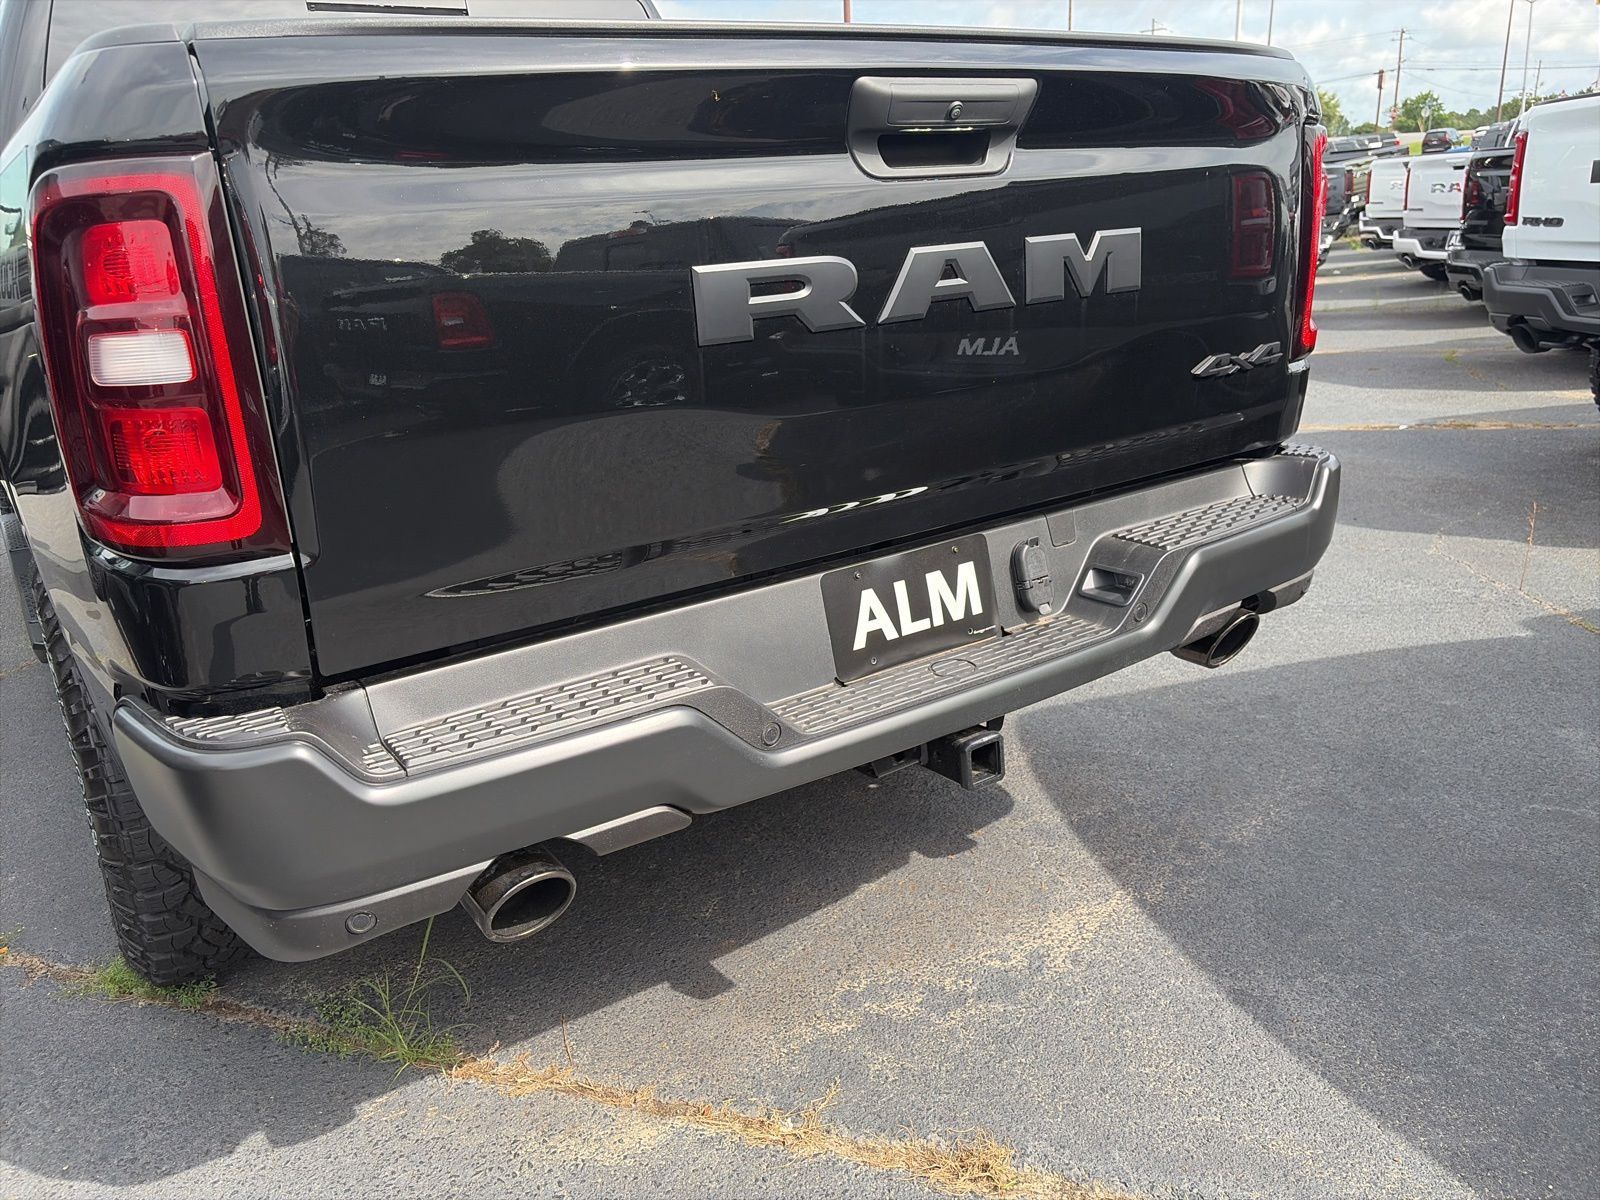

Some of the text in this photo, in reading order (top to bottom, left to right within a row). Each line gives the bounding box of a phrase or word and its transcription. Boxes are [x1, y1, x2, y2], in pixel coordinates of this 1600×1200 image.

[1430, 182, 1462, 194] RA
[692, 227, 1142, 347] RAM
[853, 560, 984, 651] ALM
